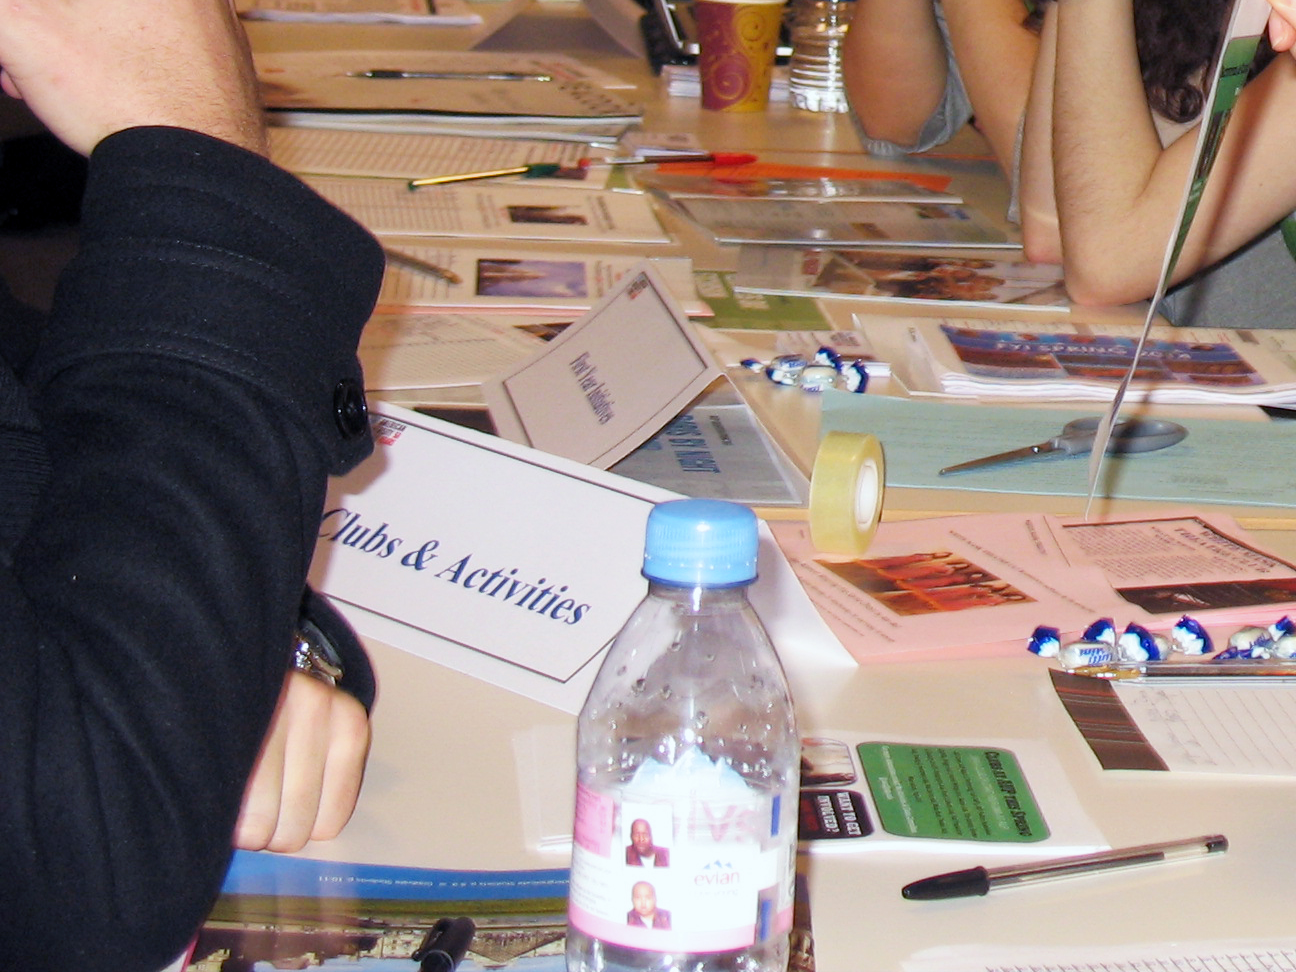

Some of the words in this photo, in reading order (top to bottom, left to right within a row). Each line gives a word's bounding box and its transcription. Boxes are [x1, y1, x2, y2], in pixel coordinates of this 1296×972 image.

[578, 366, 598, 392] Year
[586, 383, 615, 424] Initiatives
[318, 508, 403, 558] Clubs
[400, 539, 440, 571] &
[434, 553, 592, 625] Activities
[694, 871, 740, 887] evian
